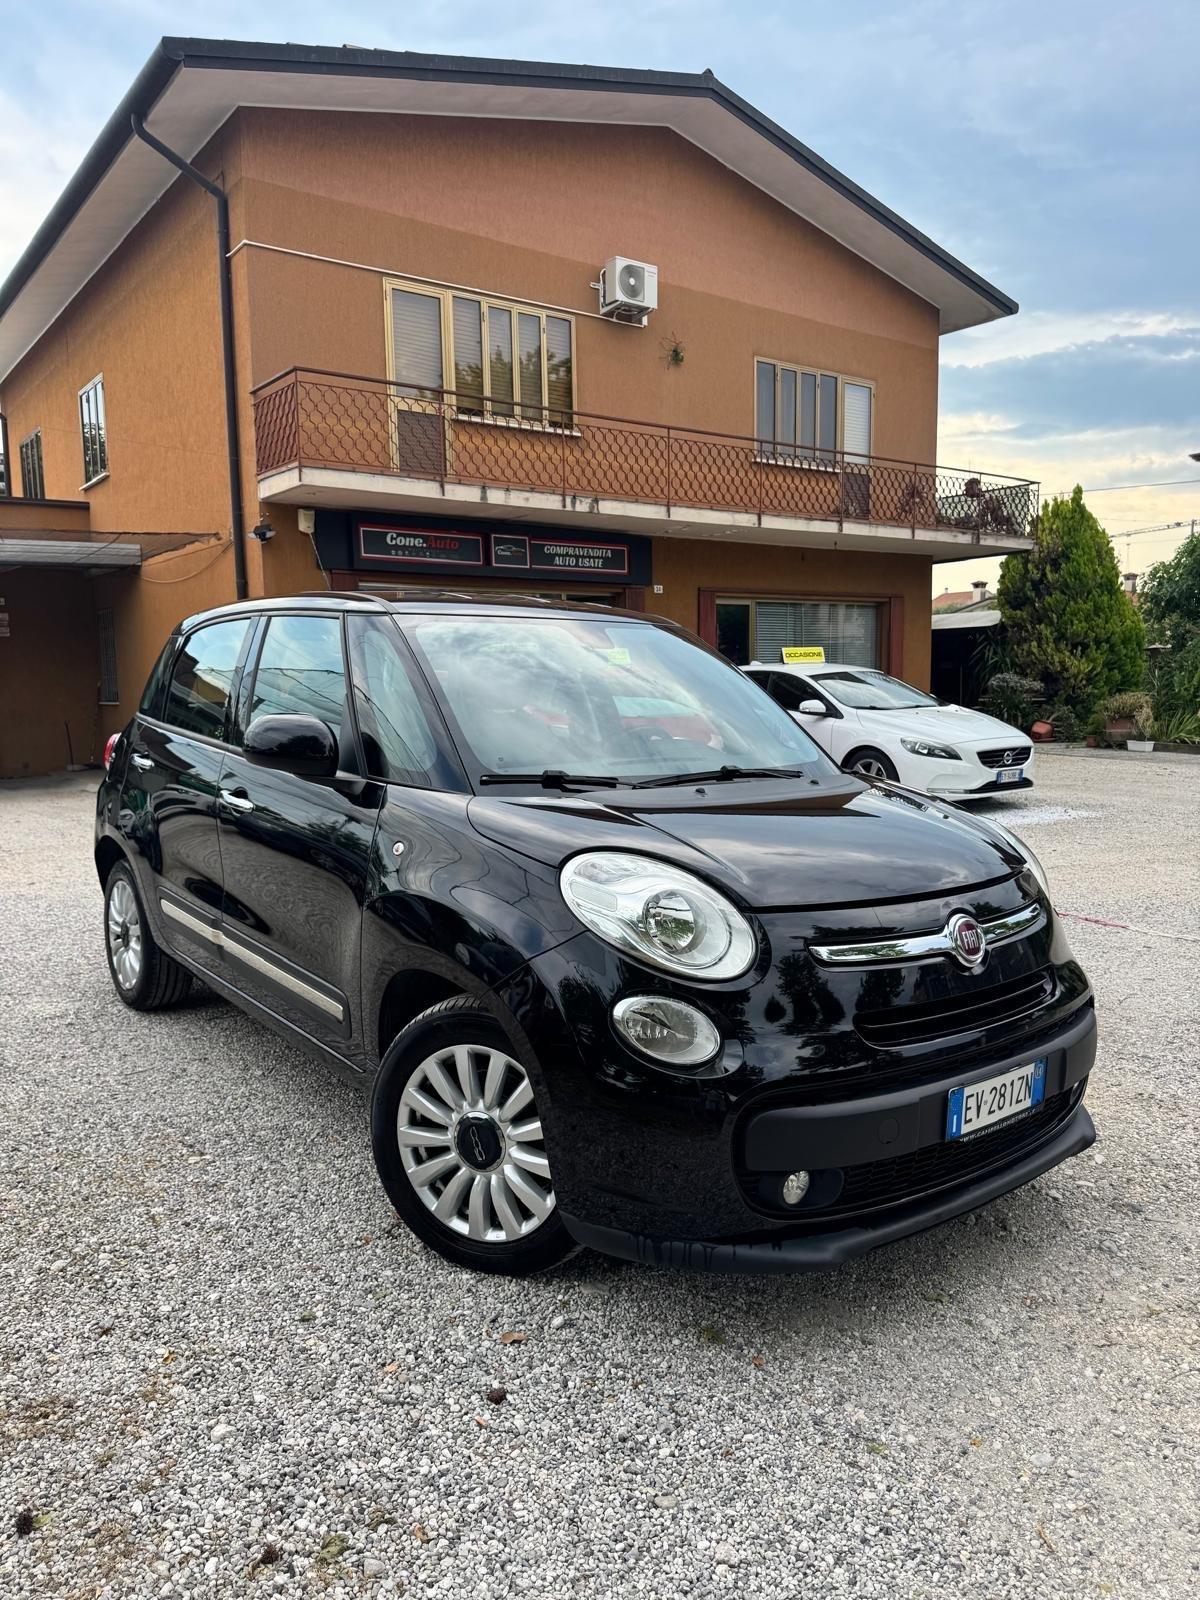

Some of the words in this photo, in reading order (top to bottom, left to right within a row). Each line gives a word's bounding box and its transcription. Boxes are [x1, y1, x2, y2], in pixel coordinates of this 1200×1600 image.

[386, 532, 460, 549] Cone.Auto
[544, 544, 612, 558] COMPRAVENDITA
[553, 556, 575, 567] AUTO
[578, 557, 604, 568] USATE
[961, 929, 978, 950] FIAT
